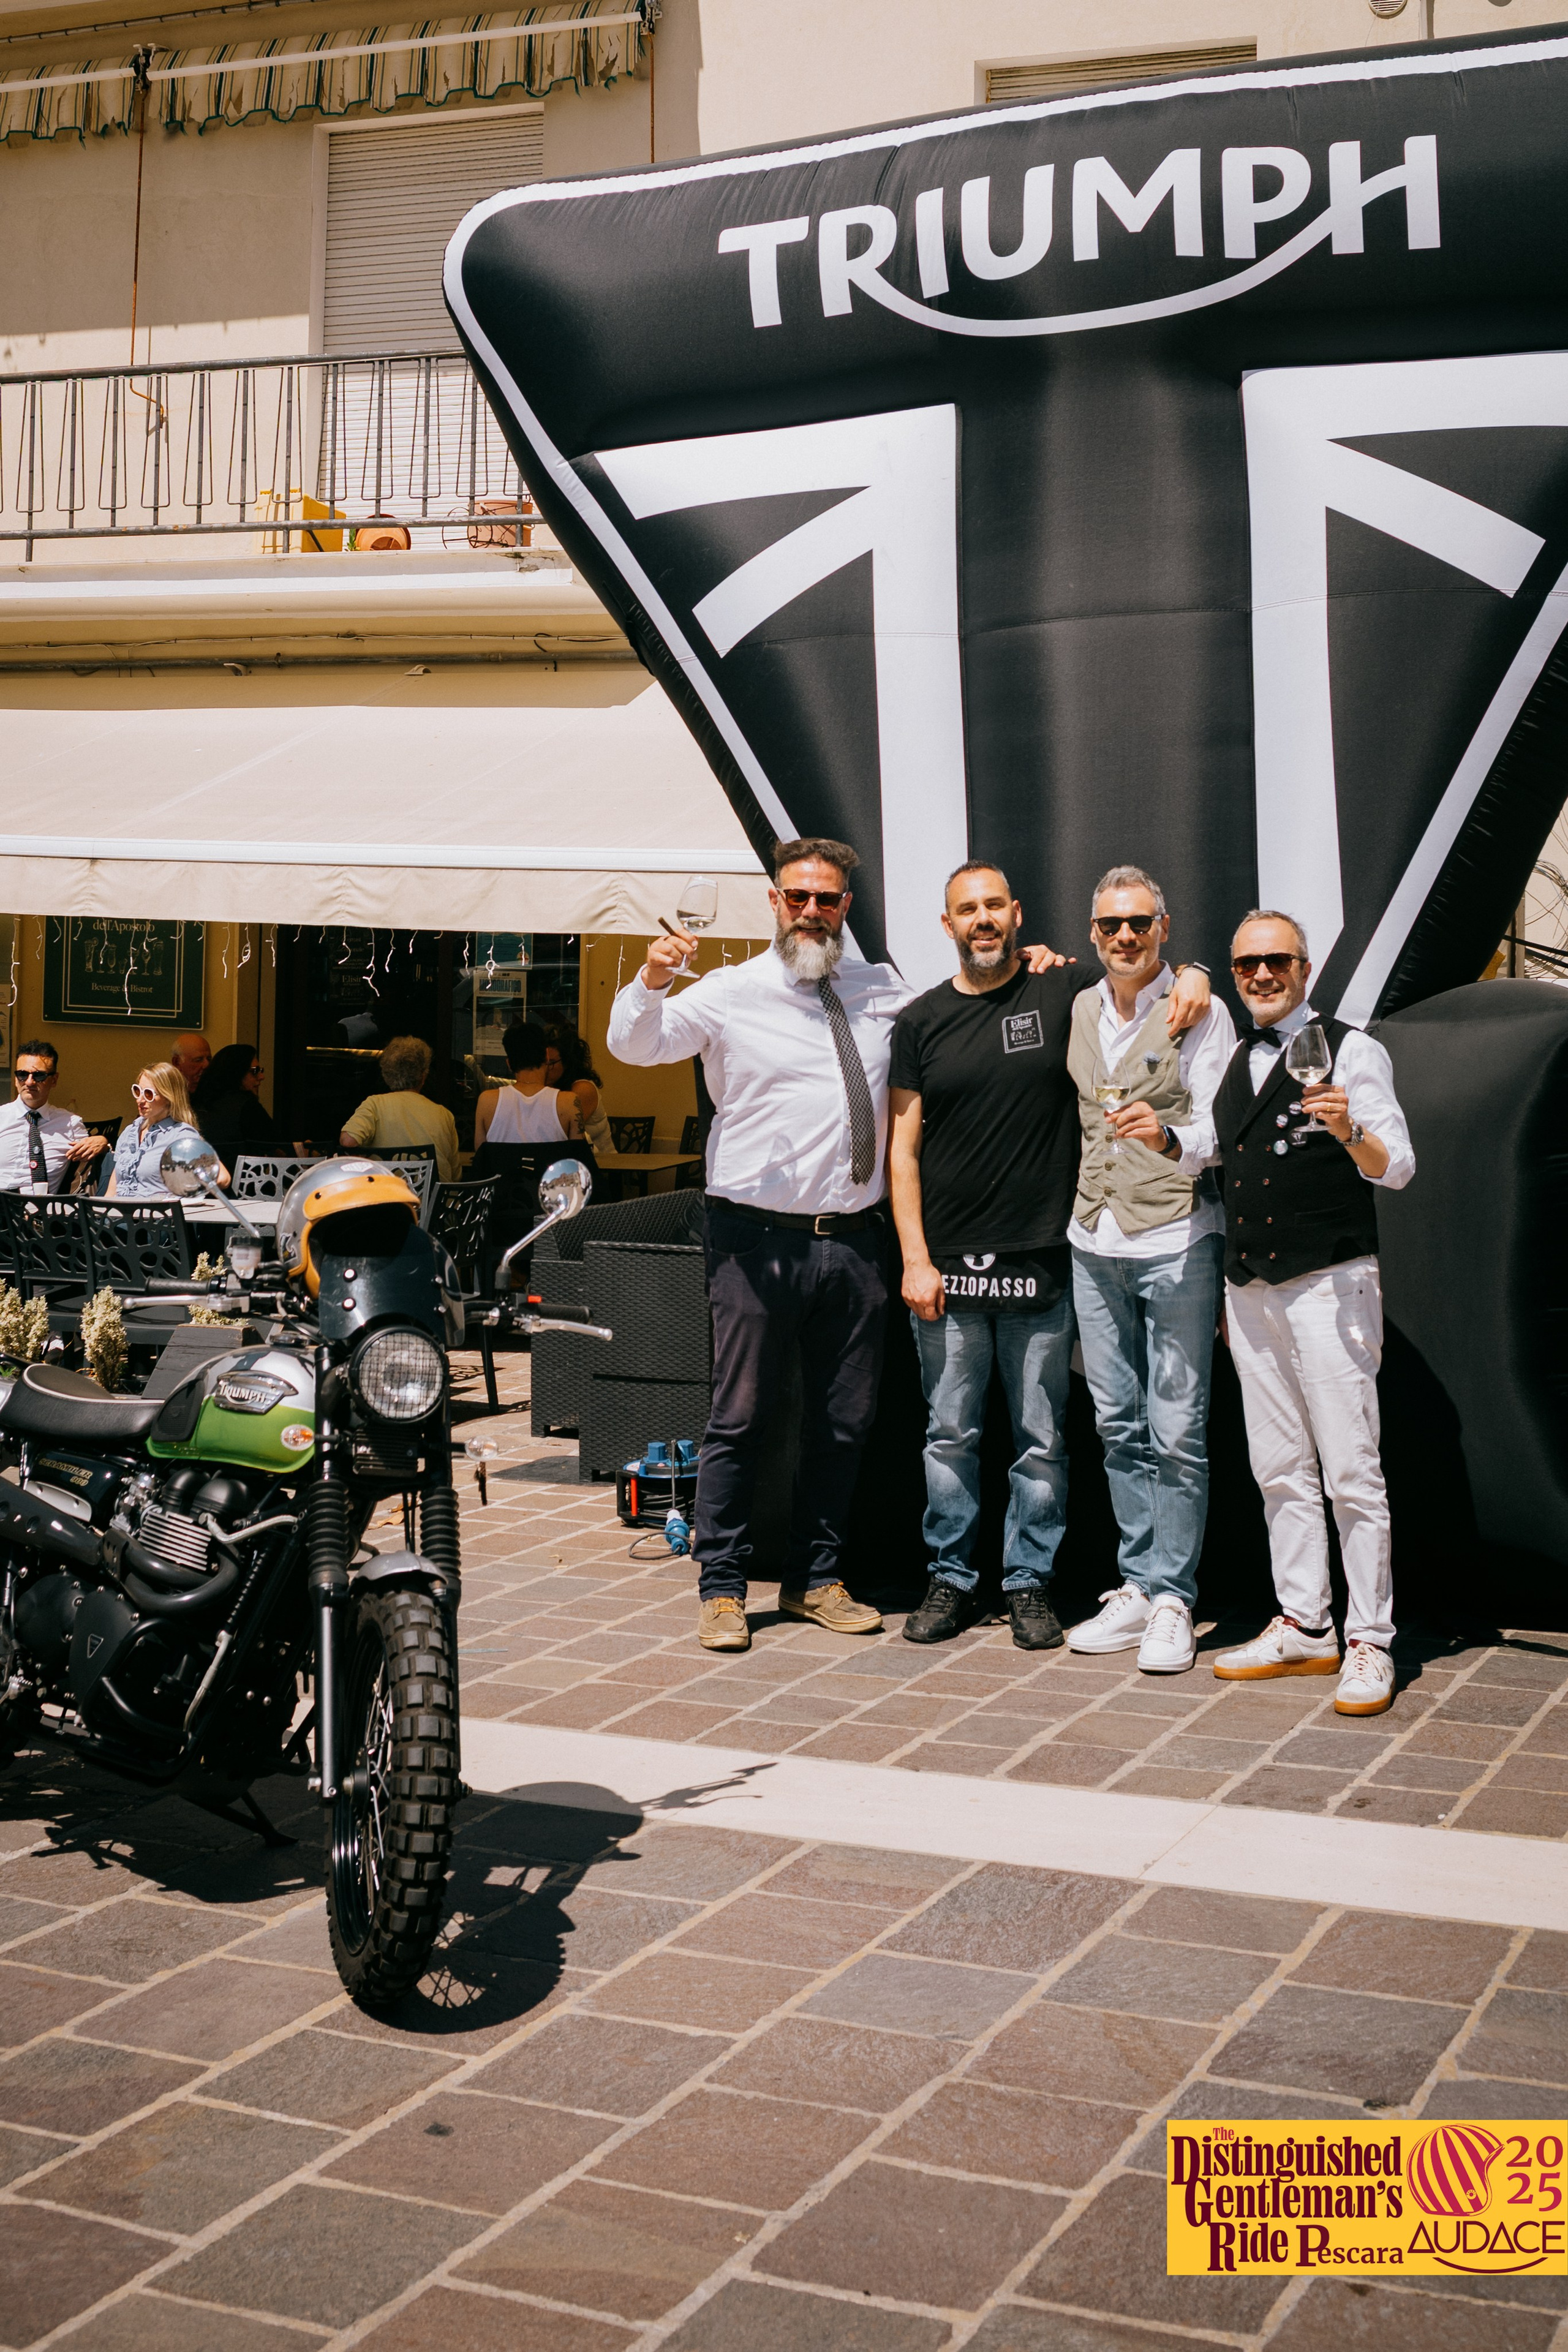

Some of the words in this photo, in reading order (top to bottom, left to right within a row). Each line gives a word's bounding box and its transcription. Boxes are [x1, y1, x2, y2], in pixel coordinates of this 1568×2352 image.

[718, 134, 1441, 337] TRIUMPH
[92, 919, 155, 934] dell'Apostolo
[91, 982, 121, 993] Beverage
[130, 984, 153, 993] Bistrot
[1011, 1017, 1033, 1028] Elisir
[219, 1384, 267, 1405] TRIUMPH
